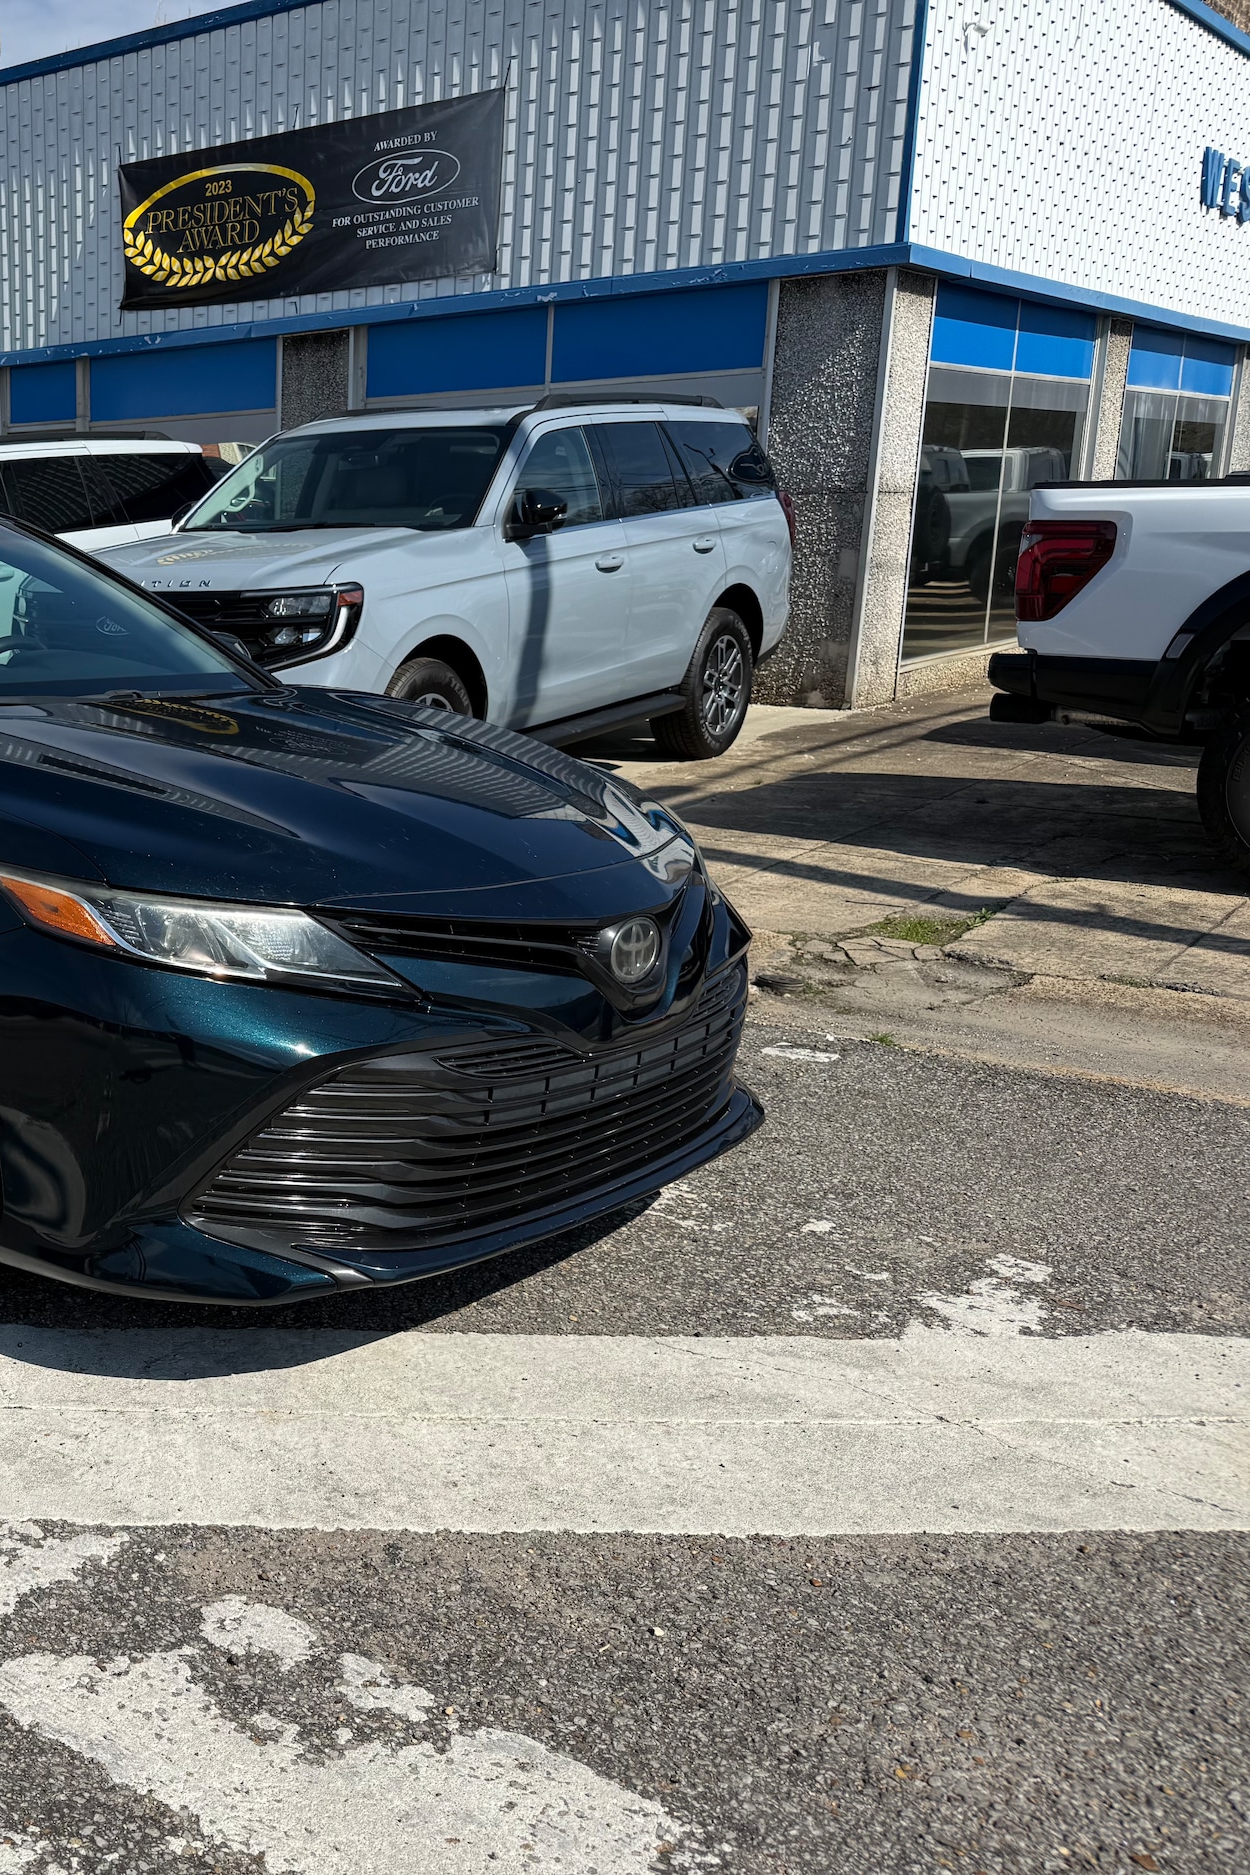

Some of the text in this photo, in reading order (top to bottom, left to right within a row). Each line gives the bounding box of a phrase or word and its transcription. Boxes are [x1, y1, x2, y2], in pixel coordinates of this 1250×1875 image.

[373, 131, 438, 152] AWARDED BY
[205, 179, 233, 197] 2023
[371, 156, 439, 197] Ford
[145, 187, 299, 235] PRESIDENT'S
[332, 196, 479, 228] FOR OUTSTANDING CUSTOMER
[177, 219, 260, 253] AWARD
[356, 214, 453, 238] SERVICE AND SALES
[365, 230, 440, 250] PERFORMANCE
